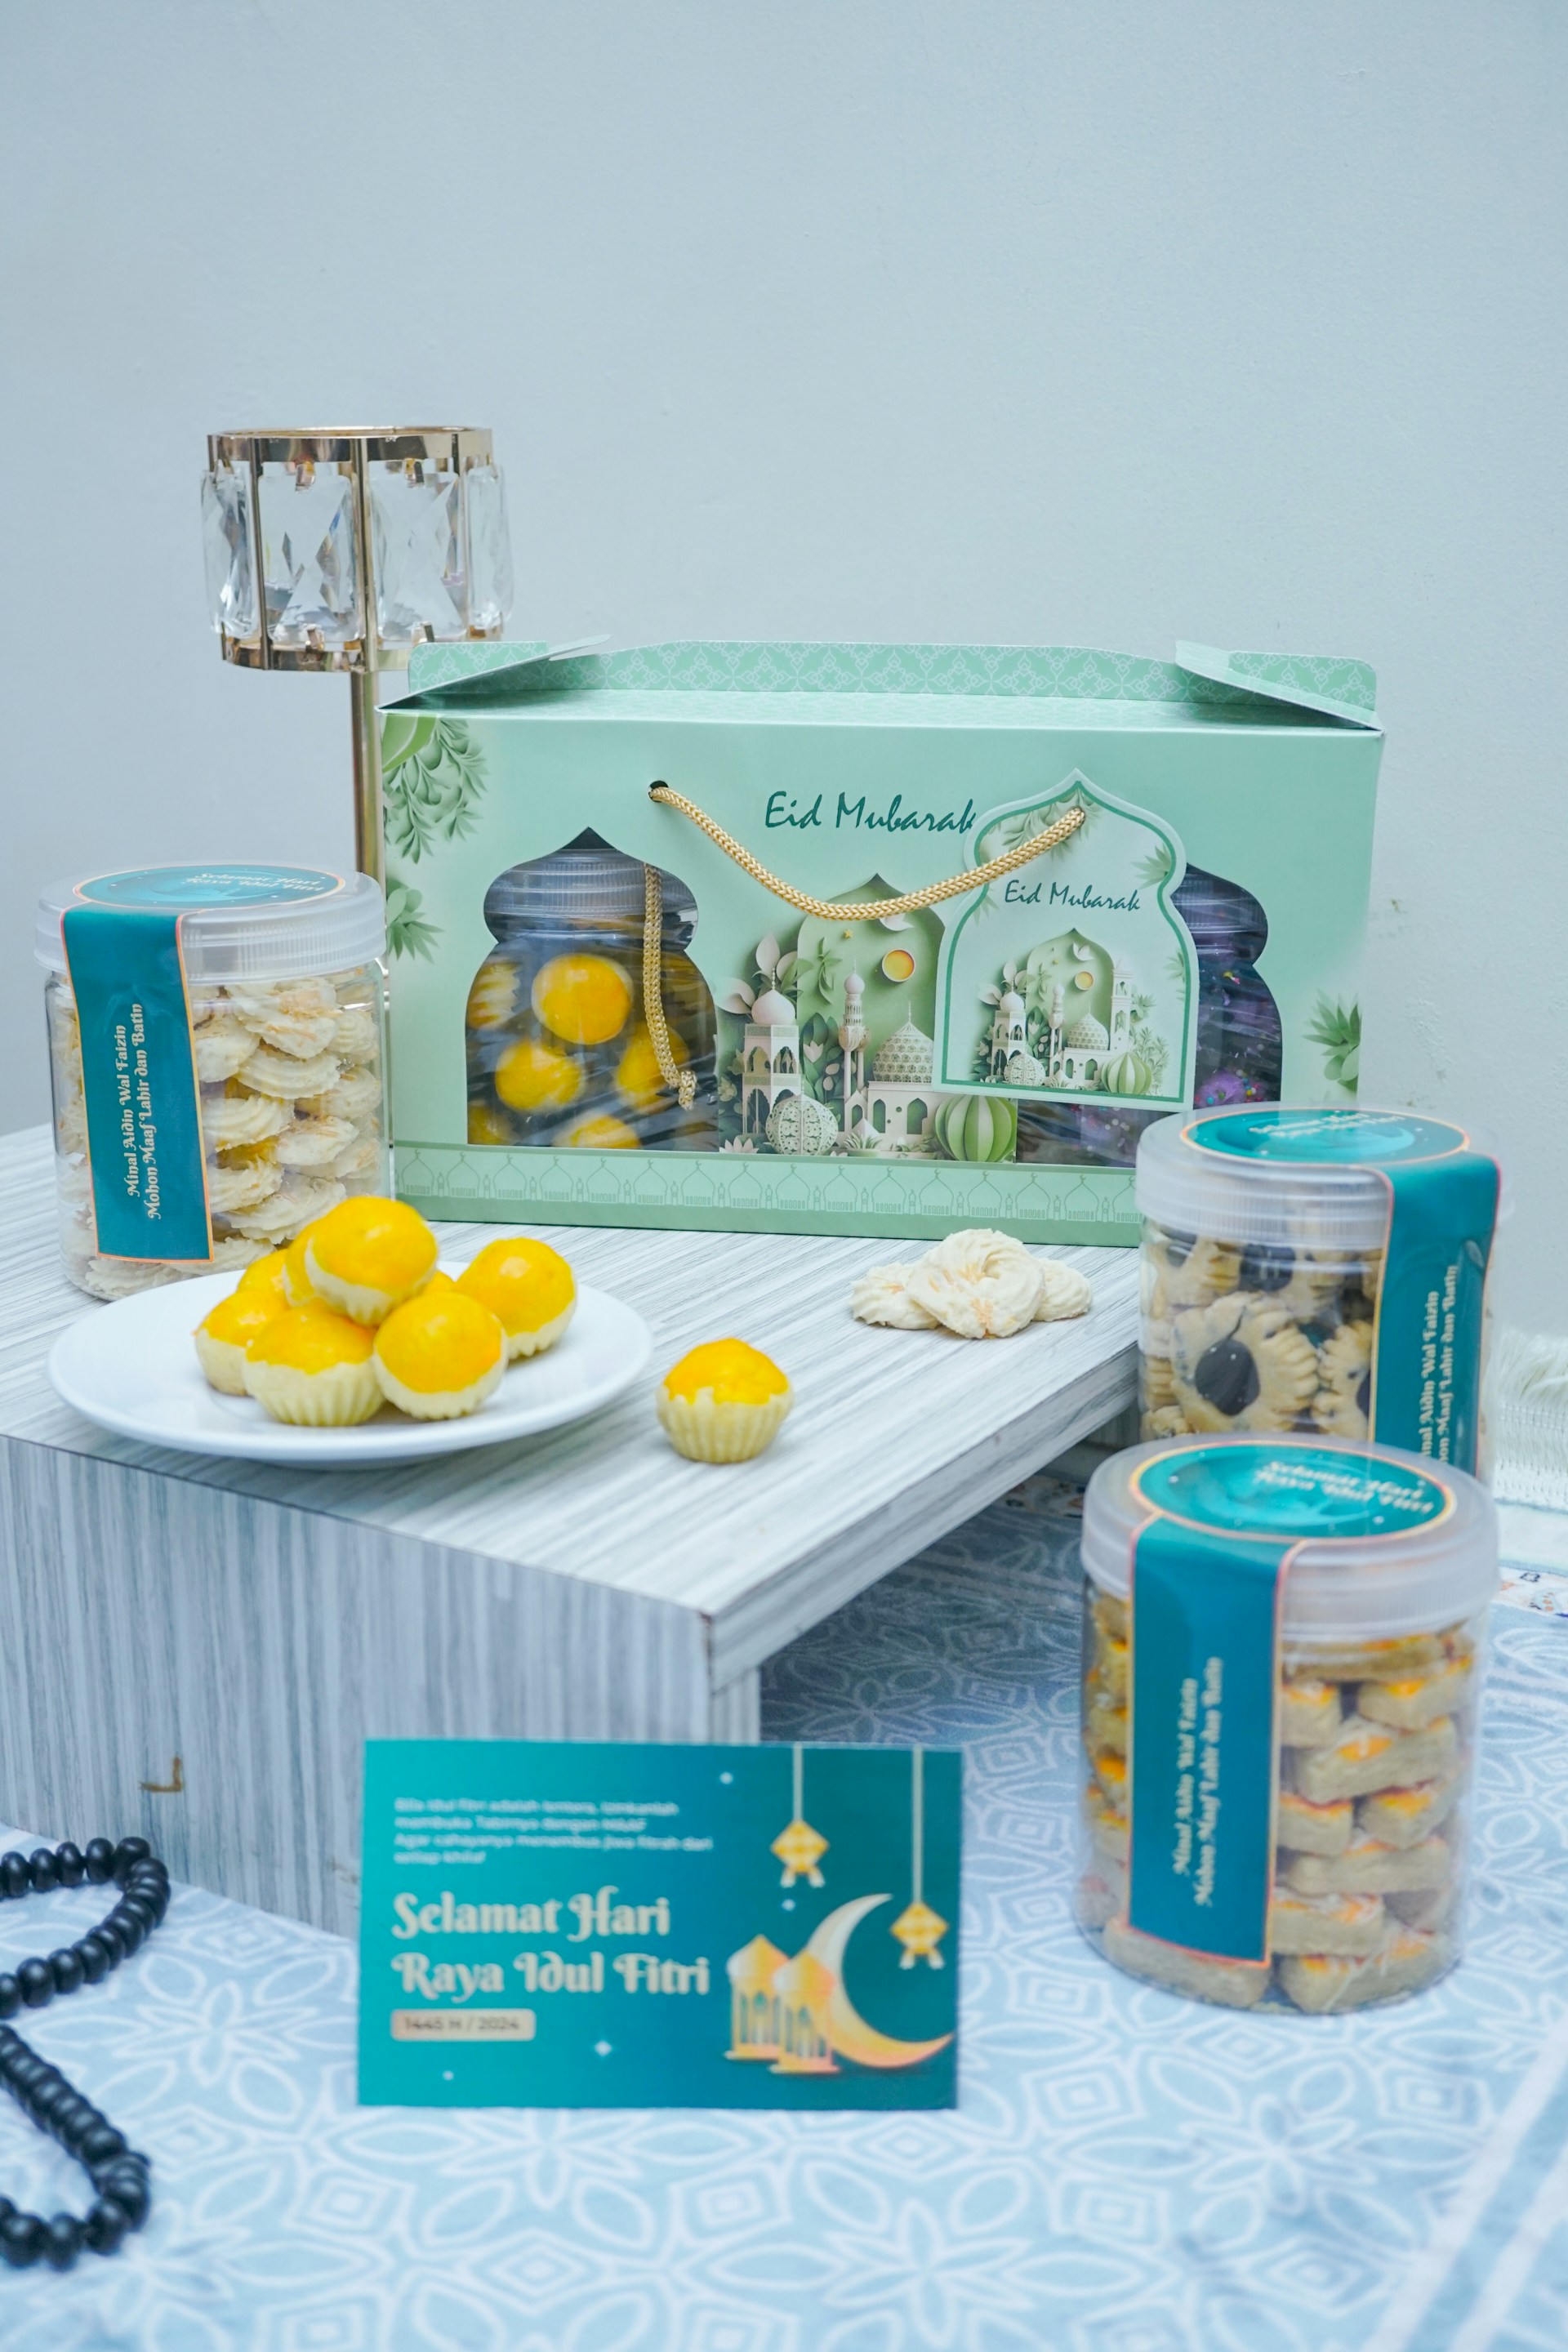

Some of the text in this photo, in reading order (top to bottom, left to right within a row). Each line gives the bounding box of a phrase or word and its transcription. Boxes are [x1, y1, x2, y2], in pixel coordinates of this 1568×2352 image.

[764, 791, 977, 834] Eid Mubarak
[1004, 879, 1140, 911] Eid Mubarak
[114, 1025, 140, 1197] Minal Aidin Wal Faizin
[130, 1004, 162, 1219] Mohon Maaf Lahir dan Batin
[1442, 1265, 1459, 1312] Batin
[1419, 1290, 1439, 1455] inal Aidin Wal Faizin
[1438, 1345, 1454, 1390] Lahir
[1435, 1392, 1454, 1435] Maaf
[391, 1885, 670, 1942] Selamat Hari
[390, 1951, 710, 2004] Raya Idul Fitri
